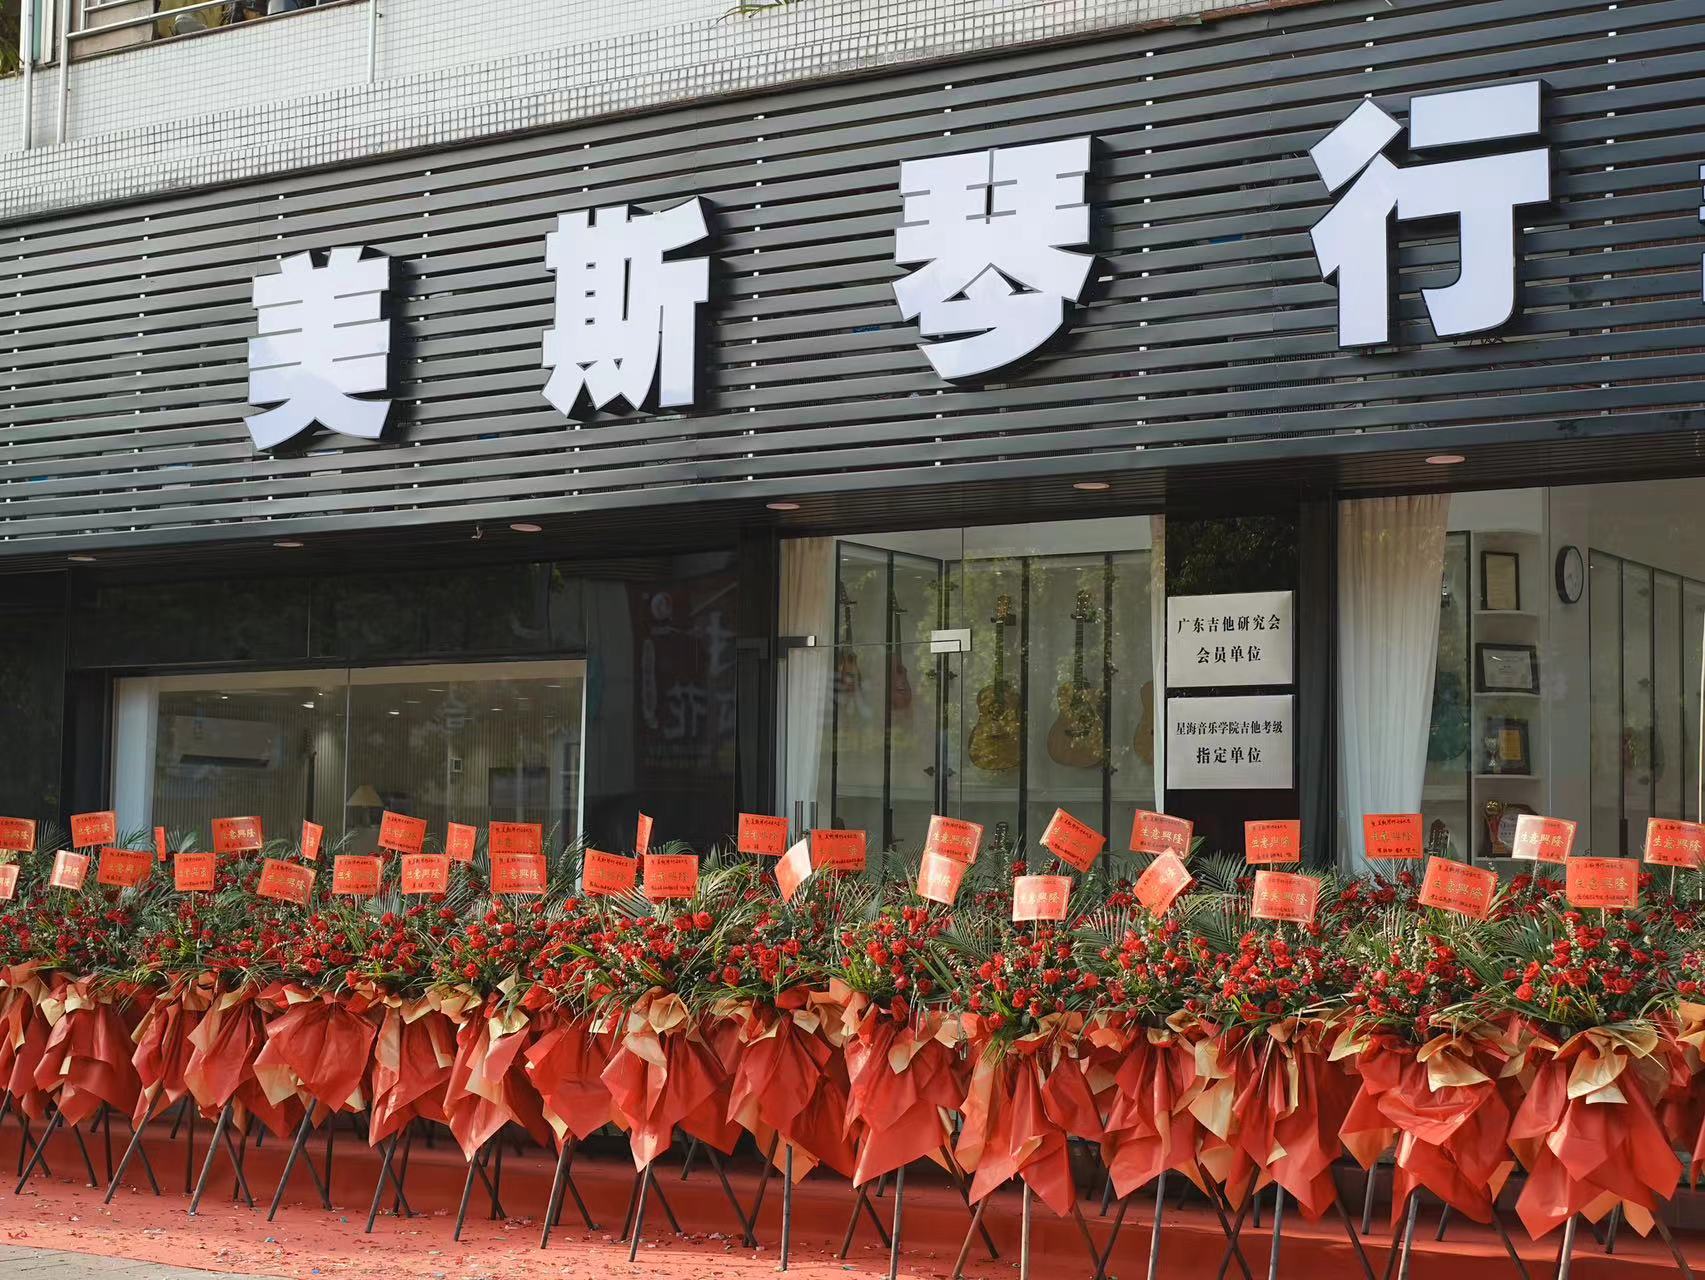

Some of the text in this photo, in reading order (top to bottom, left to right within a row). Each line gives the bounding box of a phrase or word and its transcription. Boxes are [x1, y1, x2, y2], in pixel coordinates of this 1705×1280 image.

[243, 80, 1550, 452] 美斯琴行
[1177, 614, 1281, 634] 广东吉他研究会
[1197, 646, 1261, 664] 会员单位
[1176, 720, 1283, 736] 星海音乐学院吉他考级
[1196, 747, 1262, 764] 指定单位
[1140, 826, 1185, 845] 生意興隆
[1652, 835, 1702, 852] 生意興隆
